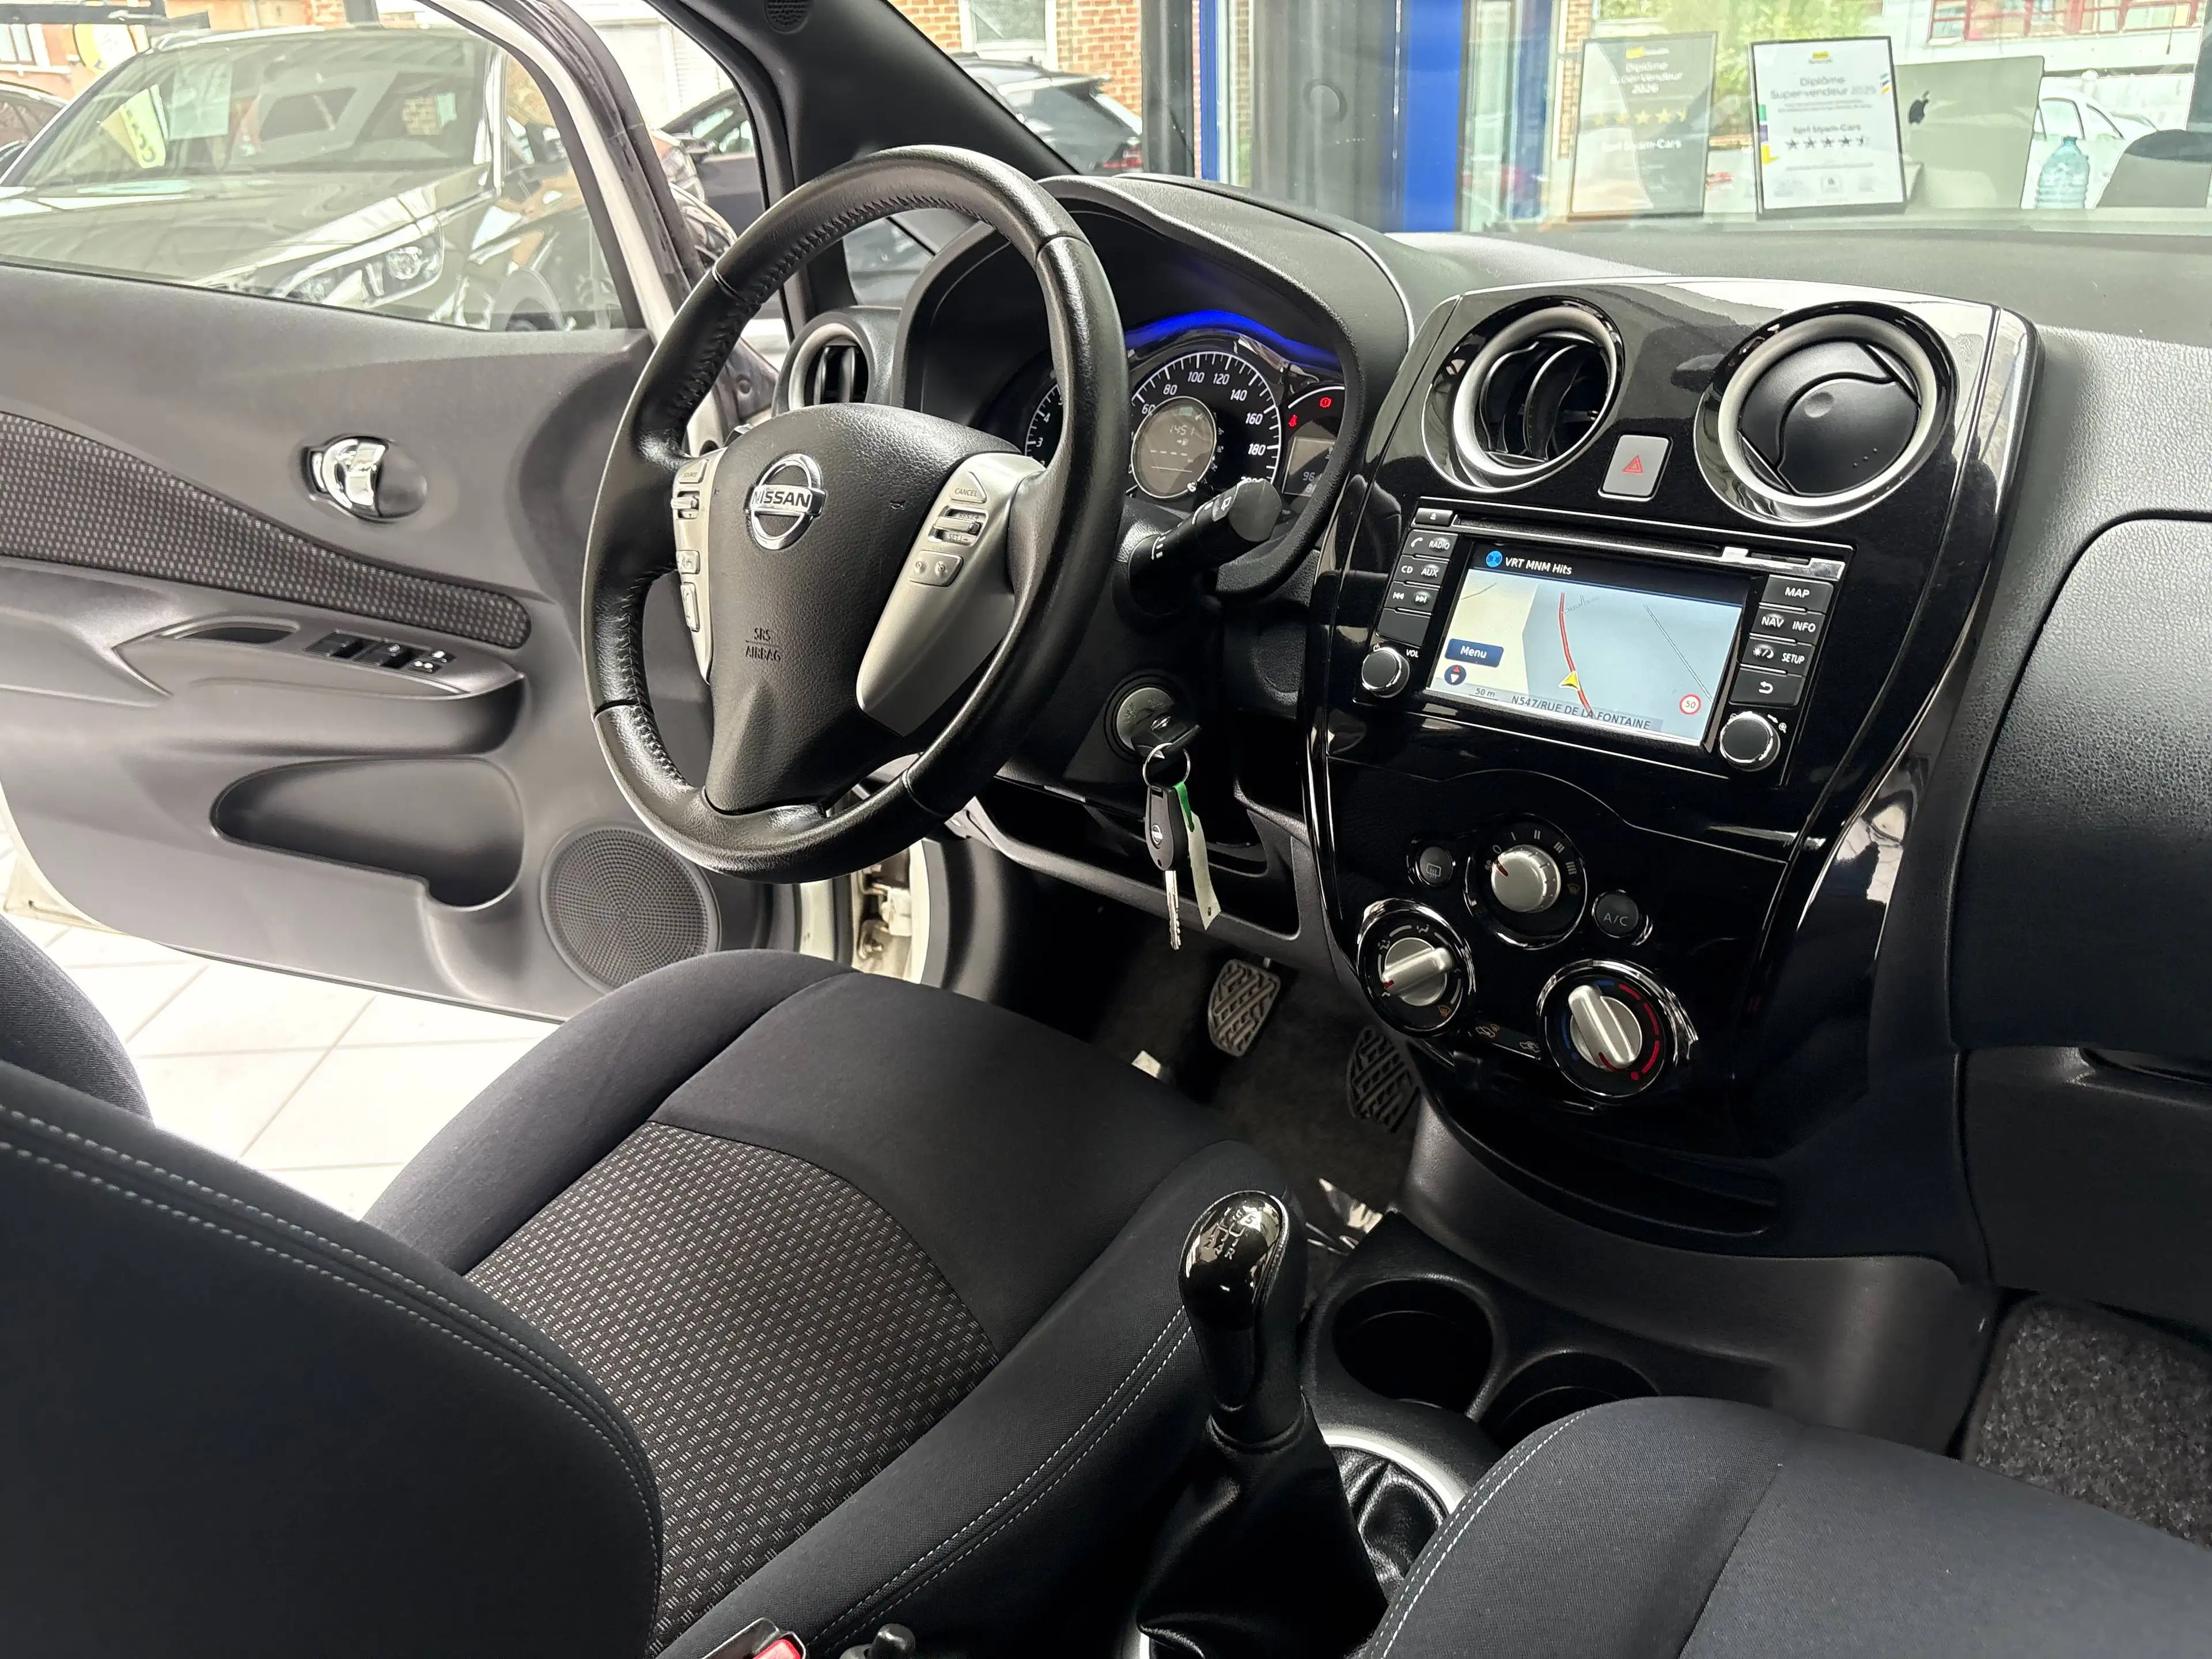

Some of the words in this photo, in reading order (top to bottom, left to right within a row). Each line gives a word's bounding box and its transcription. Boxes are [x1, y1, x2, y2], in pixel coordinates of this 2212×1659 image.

[1799, 76, 1846, 86] Diplôme
[1187, 372, 1205, 383] 100
[1213, 373, 1230, 385] 120
[1162, 384, 1177, 395] 80
[1230, 389, 1248, 402] 140
[1043, 413, 1051, 423] 4
[1245, 412, 1263, 425] 160
[1036, 437, 1043, 448] 3
[1248, 444, 1266, 456] 180
[955, 487, 978, 497] CANCEL
[751, 489, 811, 508] NISSAN
[1429, 540, 1450, 550] RADIO
[1401, 565, 1413, 574] CD
[1421, 567, 1438, 578] AUX
[1505, 556, 1524, 568] VRT
[1526, 560, 1550, 572] MNM
[1553, 563, 1572, 575] Hits
[1785, 586, 1810, 599] MAP
[1761, 616, 1784, 628] NAV
[1792, 620, 1816, 633] INFO
[753, 627, 771, 642] SRS
[745, 645, 781, 662] AIRBAG
[1406, 649, 1419, 658] VOL
[1460, 645, 1487, 659] Menu
[1781, 652, 1805, 664] SETUP
[1475, 687, 1485, 696] 50
[1685, 699, 1696, 709] 50
[1512, 695, 1562, 713] N547/RUE
[1564, 704, 1578, 716] DE
[1581, 709, 1593, 719] LA
[1597, 712, 1652, 730] FONTAINE
[1603, 912, 1628, 927] A/C
